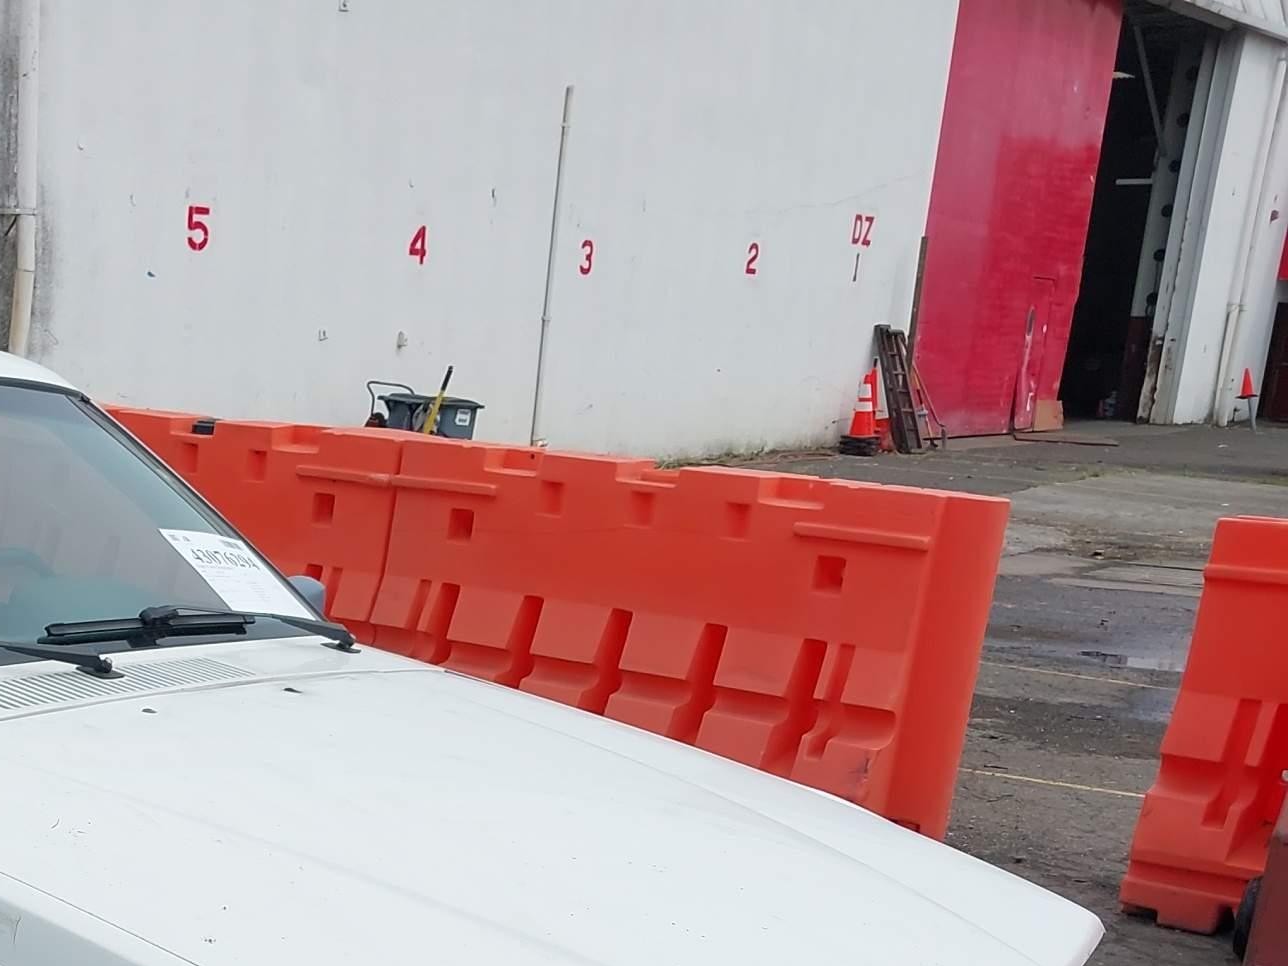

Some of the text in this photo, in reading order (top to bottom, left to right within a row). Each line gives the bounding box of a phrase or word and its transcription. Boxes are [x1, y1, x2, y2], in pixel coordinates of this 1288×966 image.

[187, 206, 210, 250] 5
[409, 225, 426, 264] 4
[851, 214, 874, 247] DZ
[580, 240, 593, 275] 3
[745, 242, 759, 274] 2
